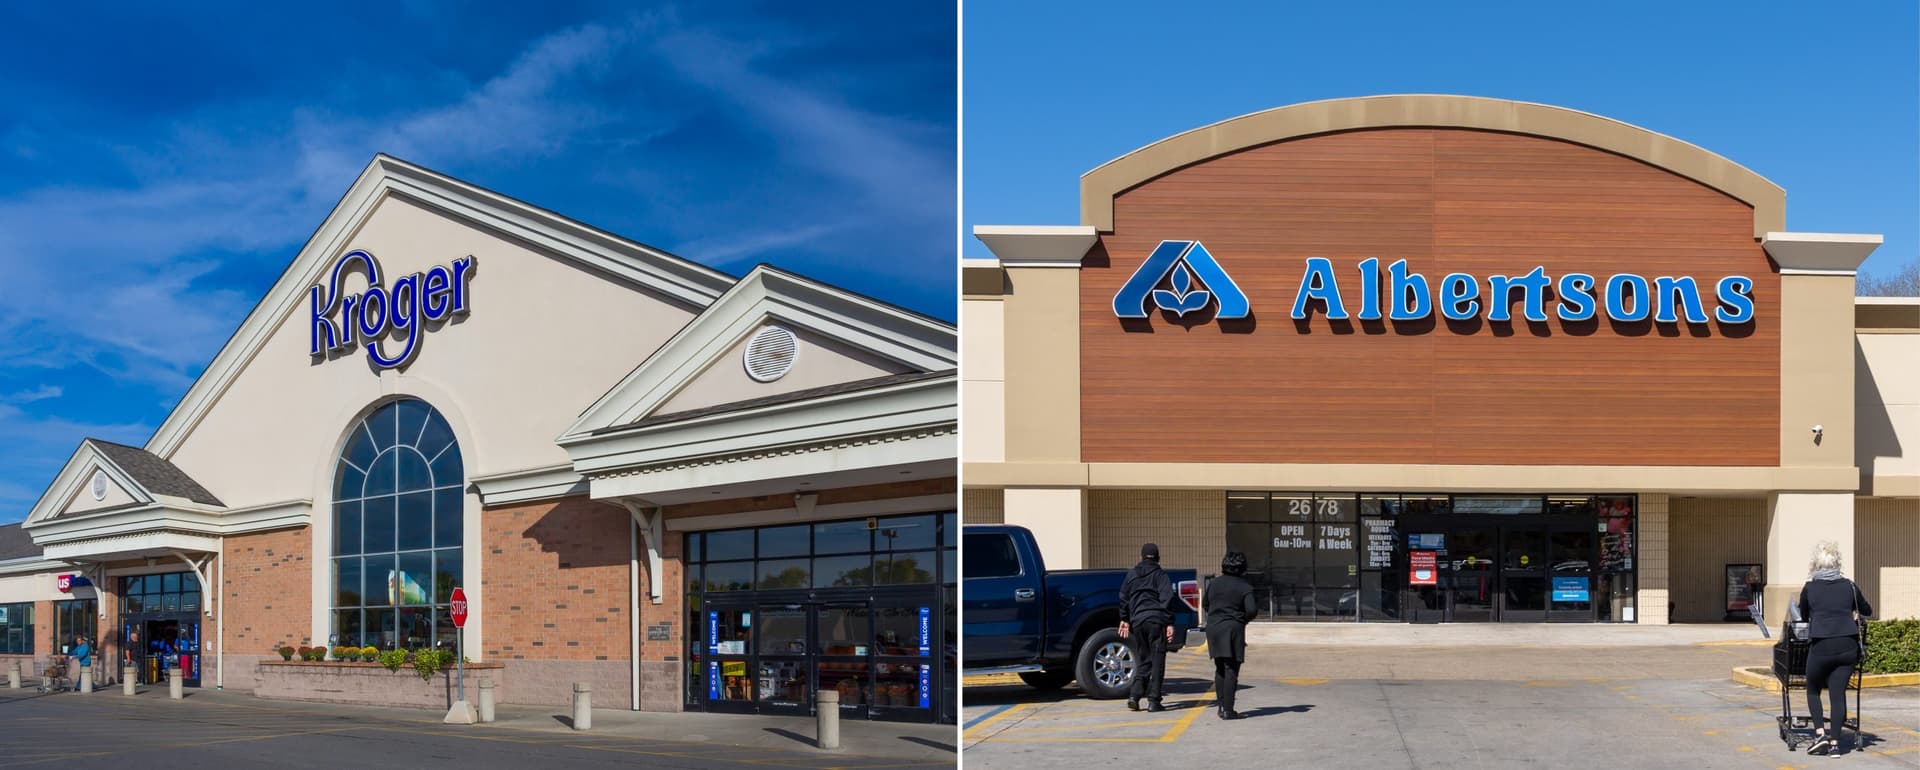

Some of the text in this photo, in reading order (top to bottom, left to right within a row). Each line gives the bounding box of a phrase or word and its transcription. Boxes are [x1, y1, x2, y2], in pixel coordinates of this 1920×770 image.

[1290, 256, 1755, 323] Albertsons
[311, 249, 473, 368] Kroger
[1281, 525, 1304, 536] OPEN
[1320, 526, 1351, 538] 7 Days
[1327, 538, 1352, 549] Week
[451, 600, 467, 615] STOP
